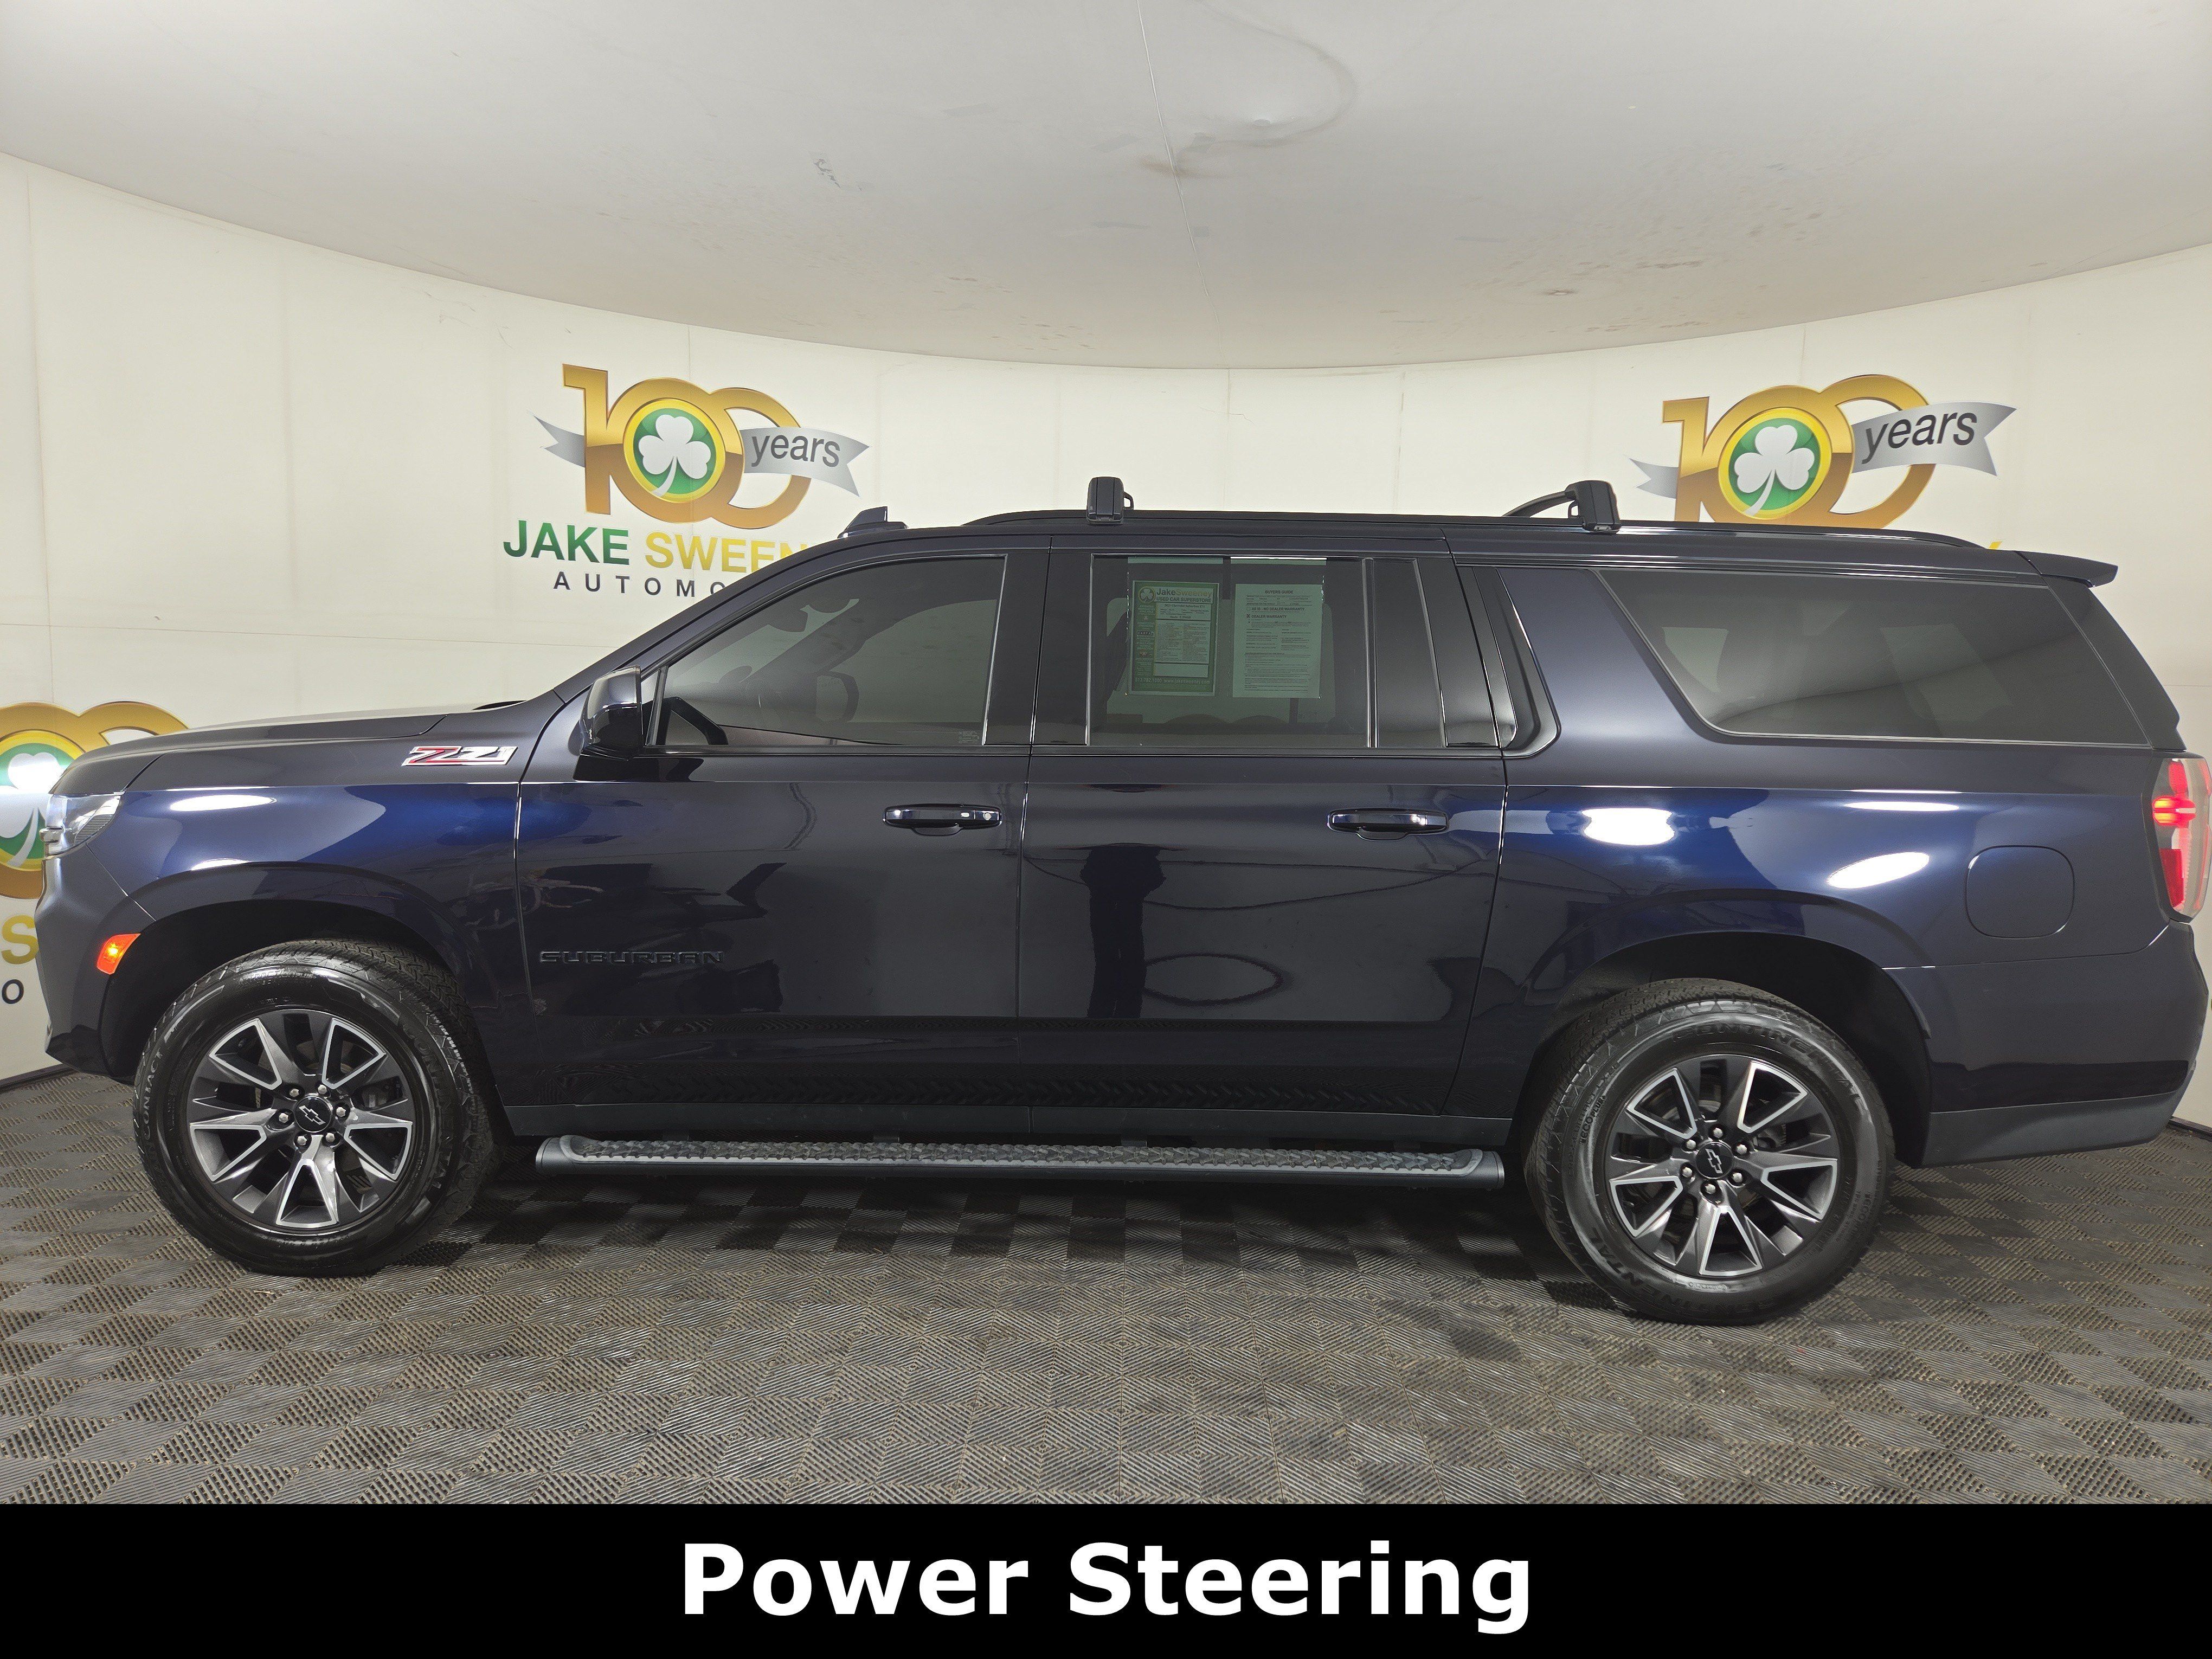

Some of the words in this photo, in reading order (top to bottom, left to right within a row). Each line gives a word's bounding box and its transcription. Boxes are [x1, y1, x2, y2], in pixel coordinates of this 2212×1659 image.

[562, 364, 812, 529] 100
[750, 434, 841, 467] years
[1861, 412, 1978, 465] years
[504, 520, 629, 566] JAKE
[401, 745, 518, 766] Z71
[540, 951, 723, 964] SUBURBAN
